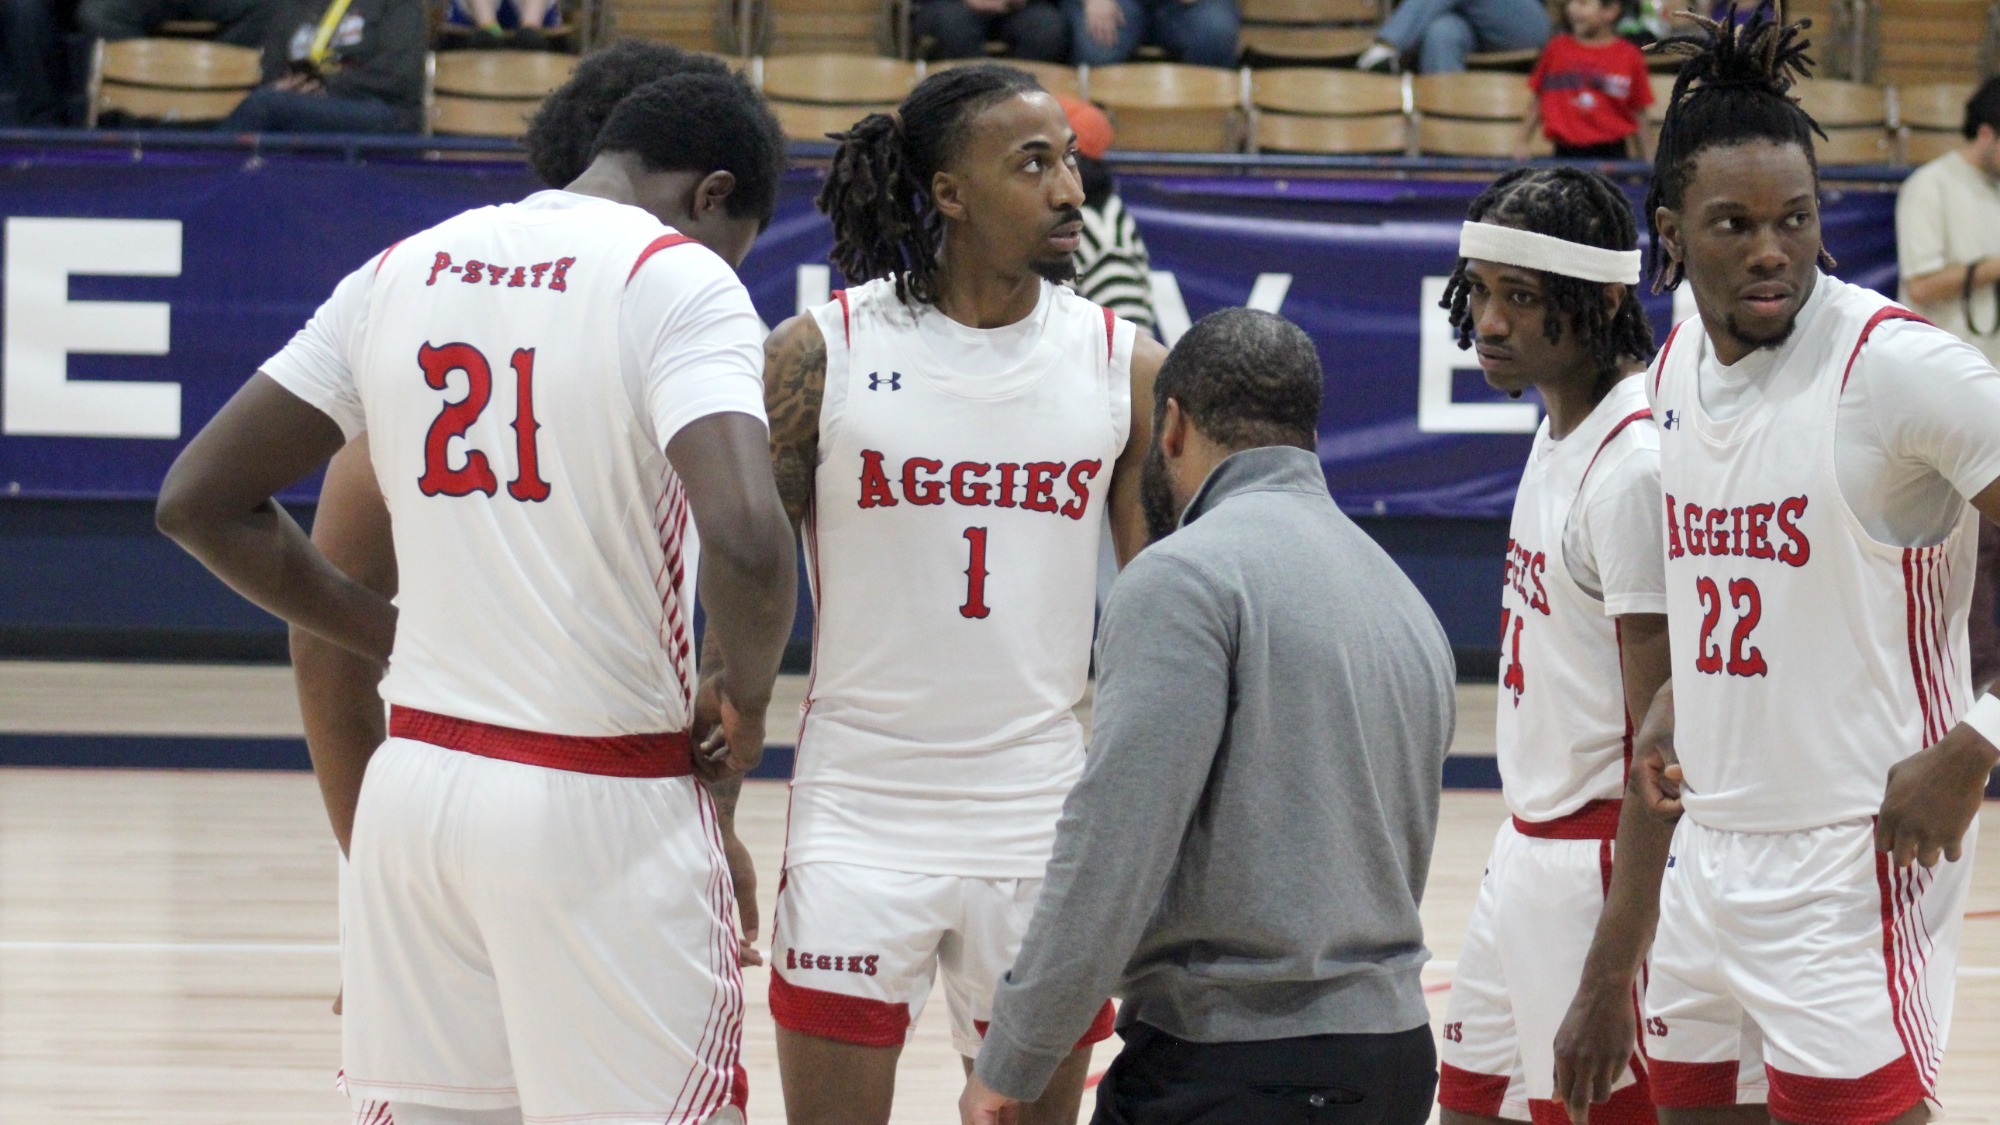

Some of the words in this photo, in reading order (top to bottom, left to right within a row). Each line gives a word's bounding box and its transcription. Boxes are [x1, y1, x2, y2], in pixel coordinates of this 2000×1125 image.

[426, 251, 576, 293] P-STATE
[417, 340, 551, 503] 21
[857, 449, 1102, 520] AGGIES
[959, 526, 990, 619] 1
[1665, 493, 1811, 568] AGGIES
[1695, 575, 1768, 678] 22
